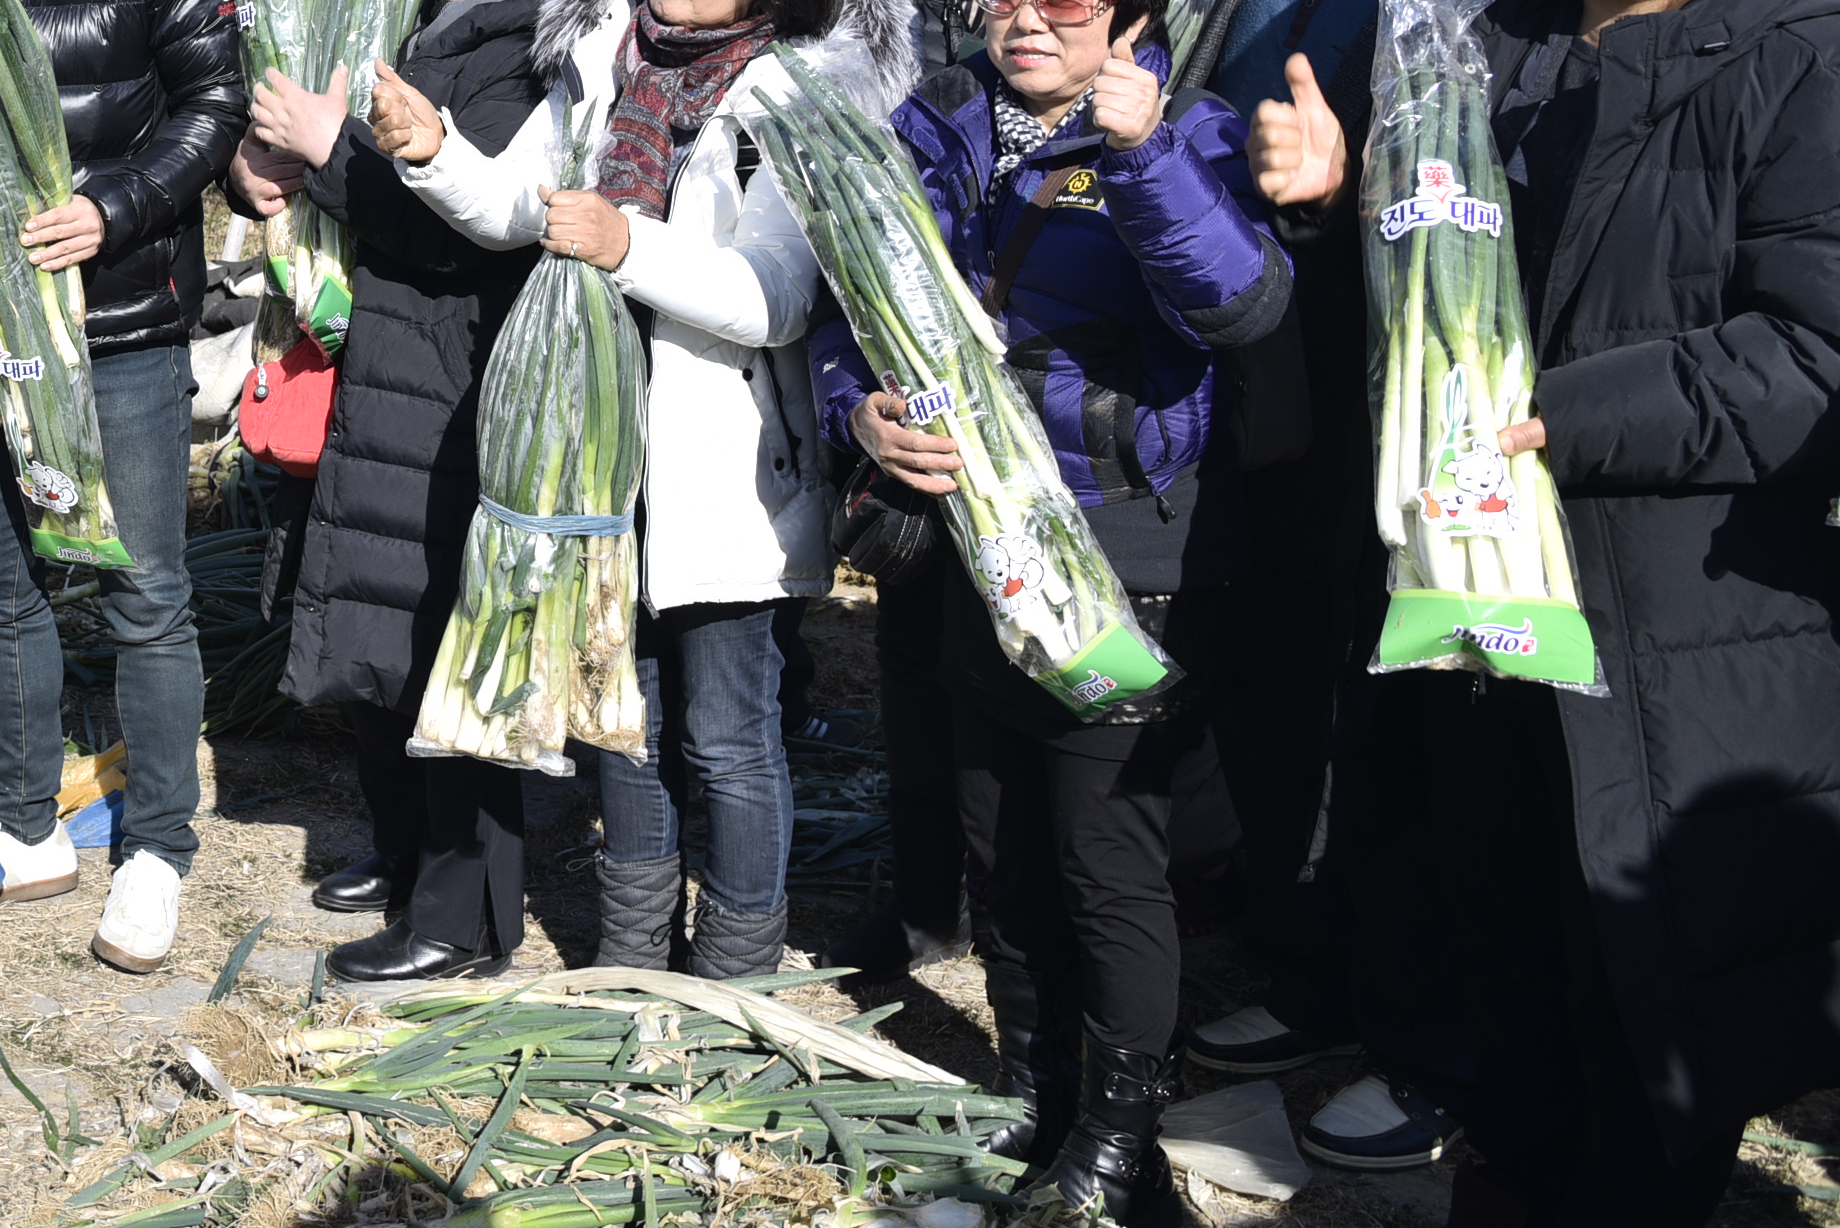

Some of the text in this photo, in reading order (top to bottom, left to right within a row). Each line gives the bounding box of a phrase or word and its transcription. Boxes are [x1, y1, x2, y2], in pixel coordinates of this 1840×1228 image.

[1423, 165, 1452, 188] 藥
[1383, 199, 1500, 236] 진도 대파
[1, 359, 42, 379] 대파
[906, 385, 952, 422] 대파
[56, 547, 92, 562] Jindo
